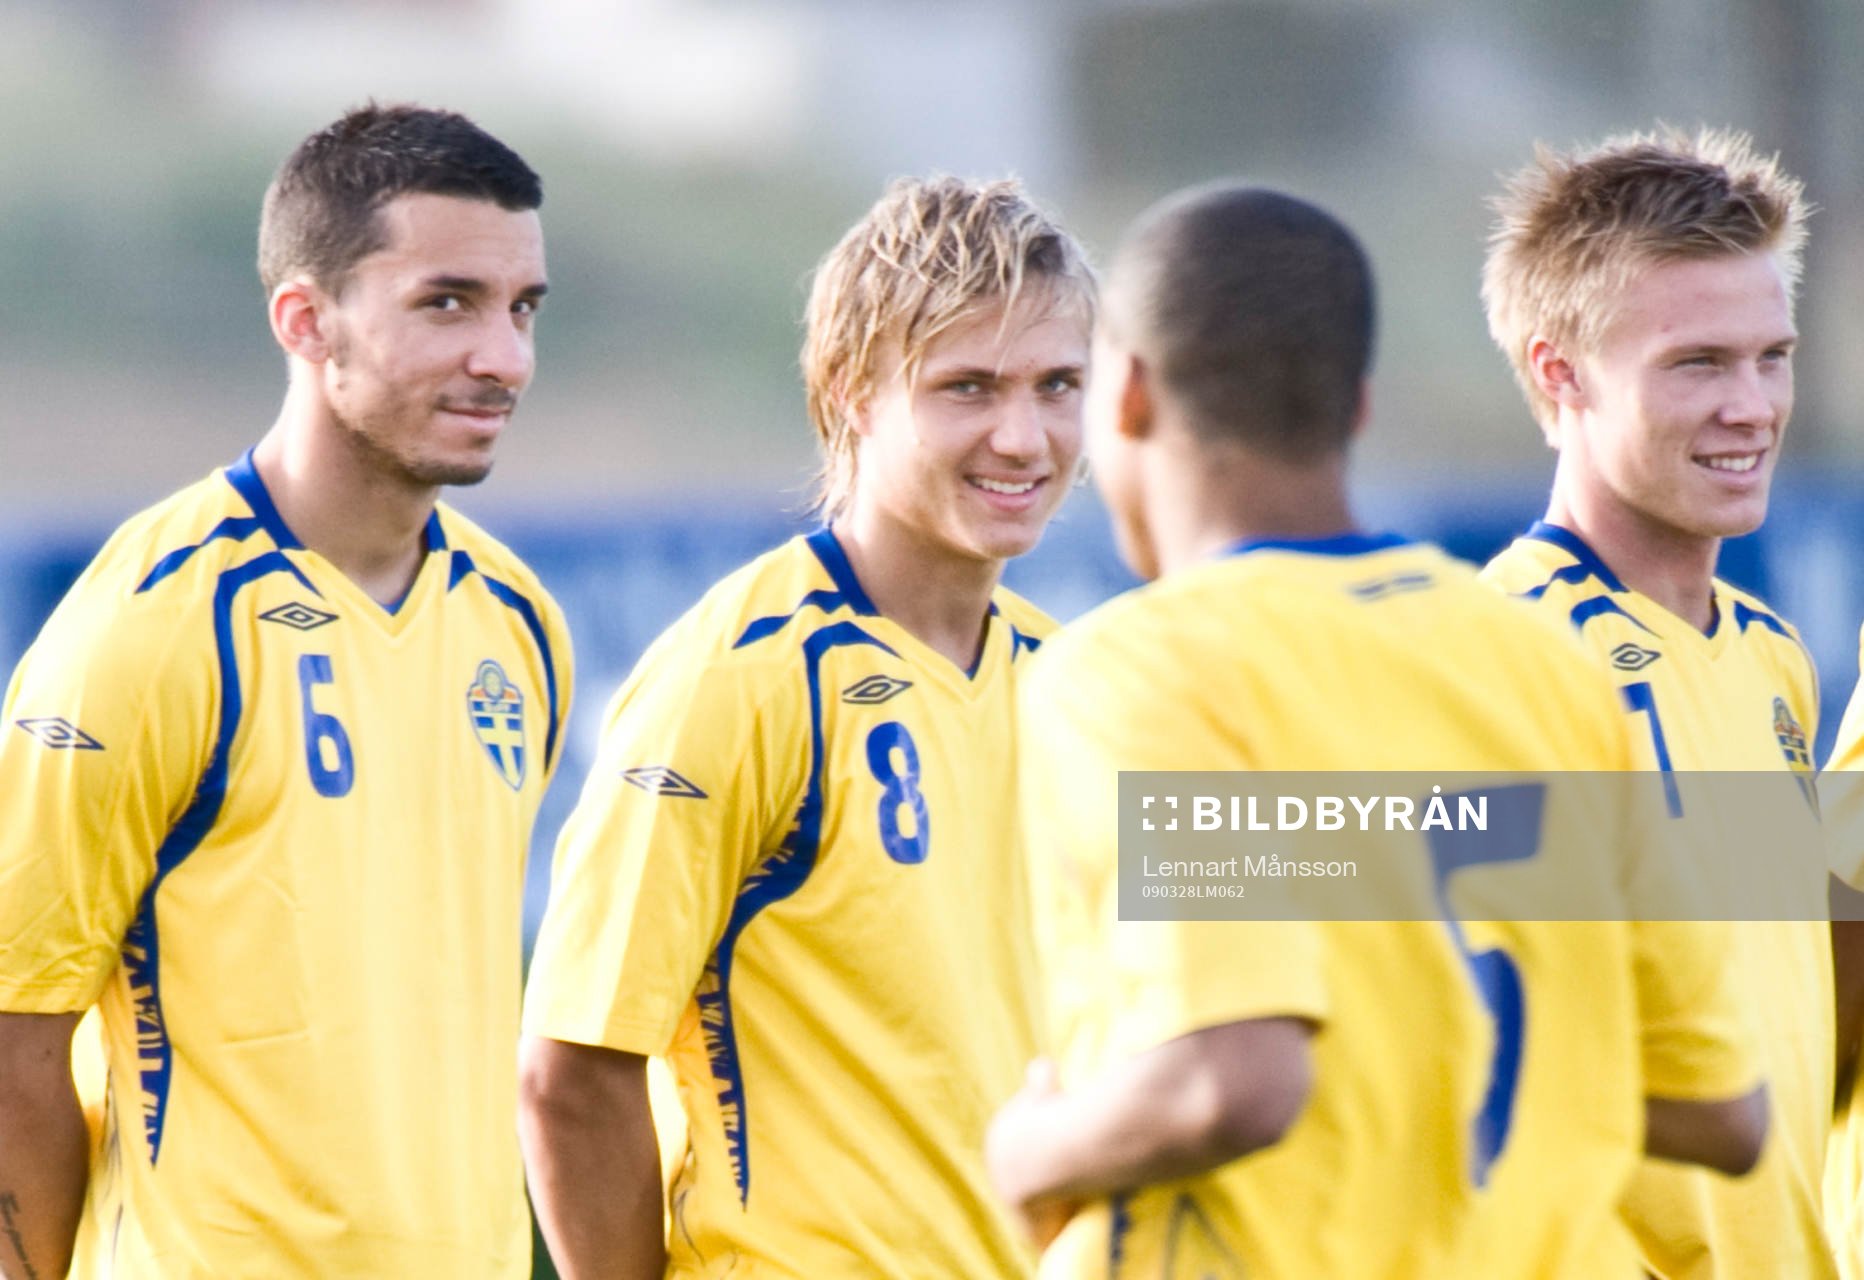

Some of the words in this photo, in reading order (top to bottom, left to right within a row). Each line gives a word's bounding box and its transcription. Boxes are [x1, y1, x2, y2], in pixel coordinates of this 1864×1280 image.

[298, 653, 355, 798] 6
[866, 721, 930, 865] 8
[1420, 782, 1546, 1191] 5
